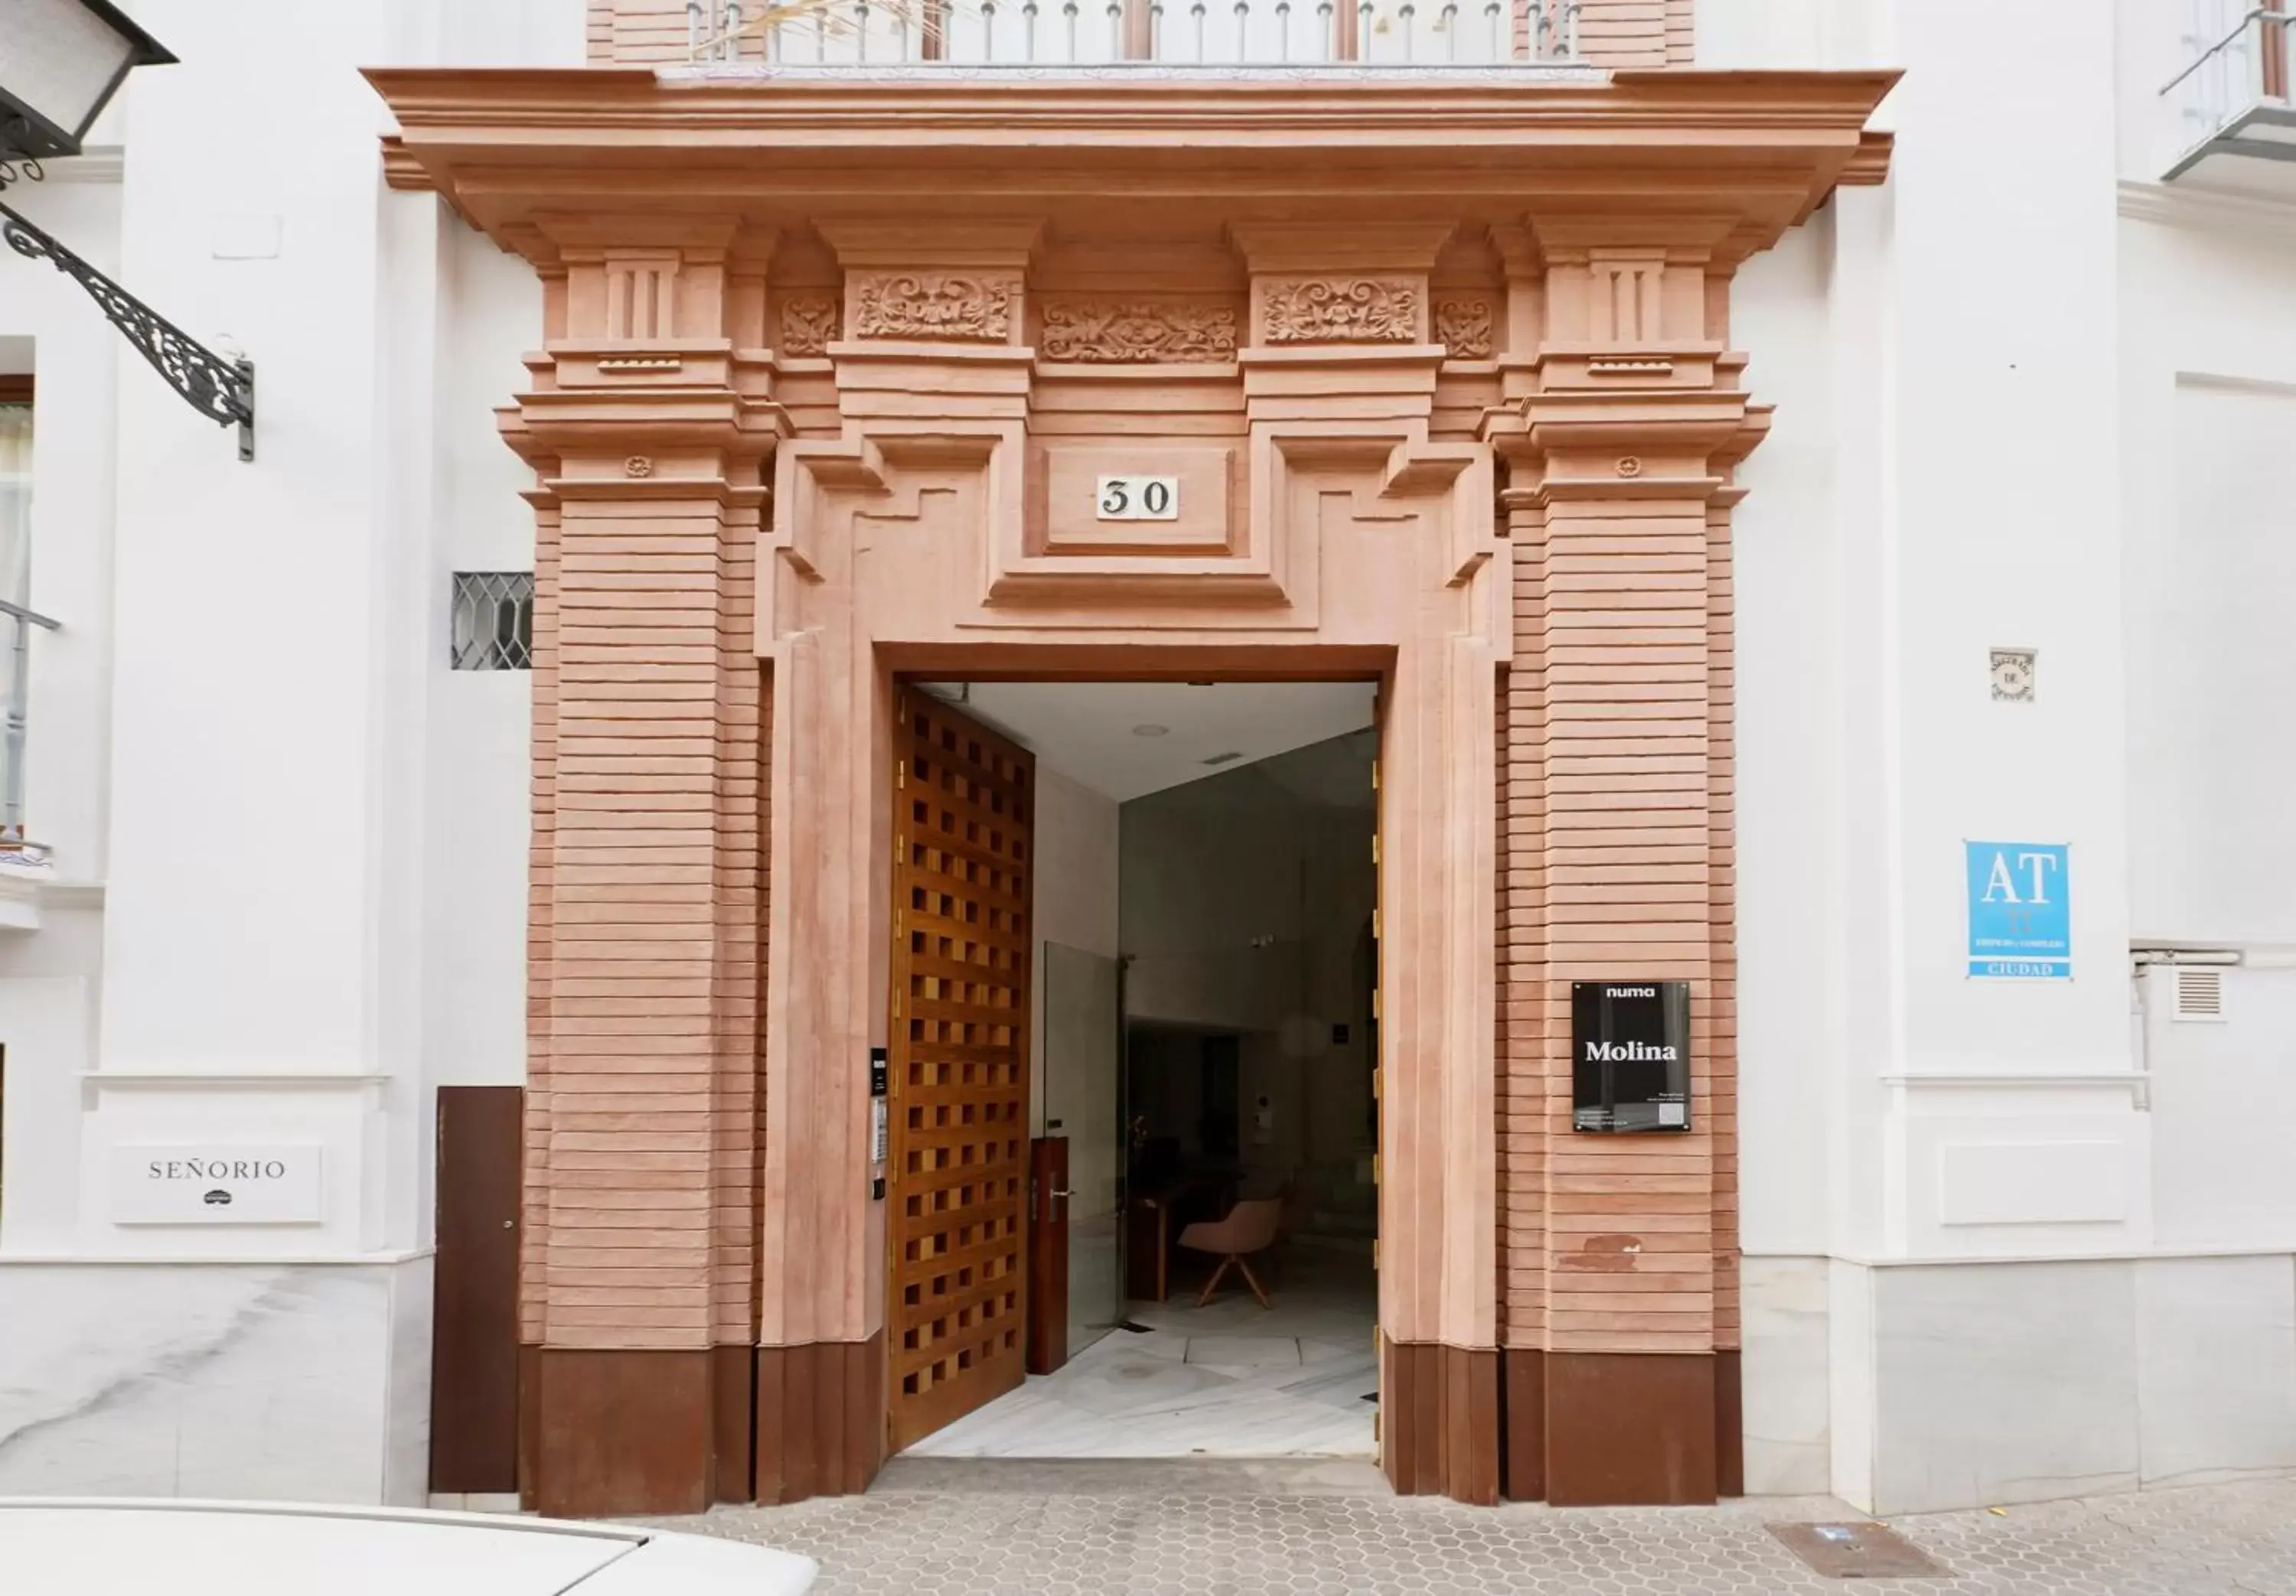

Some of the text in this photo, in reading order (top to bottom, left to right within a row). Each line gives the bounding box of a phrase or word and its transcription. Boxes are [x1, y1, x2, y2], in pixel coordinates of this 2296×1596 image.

[1102, 480, 1169, 513] 30
[1981, 851, 2057, 904] AT
[1987, 962, 2054, 977] CIUDAD
[1606, 987, 1656, 998] numa
[1585, 1040, 1678, 1061] Molina
[148, 1157, 285, 1180] SEÑORIO
